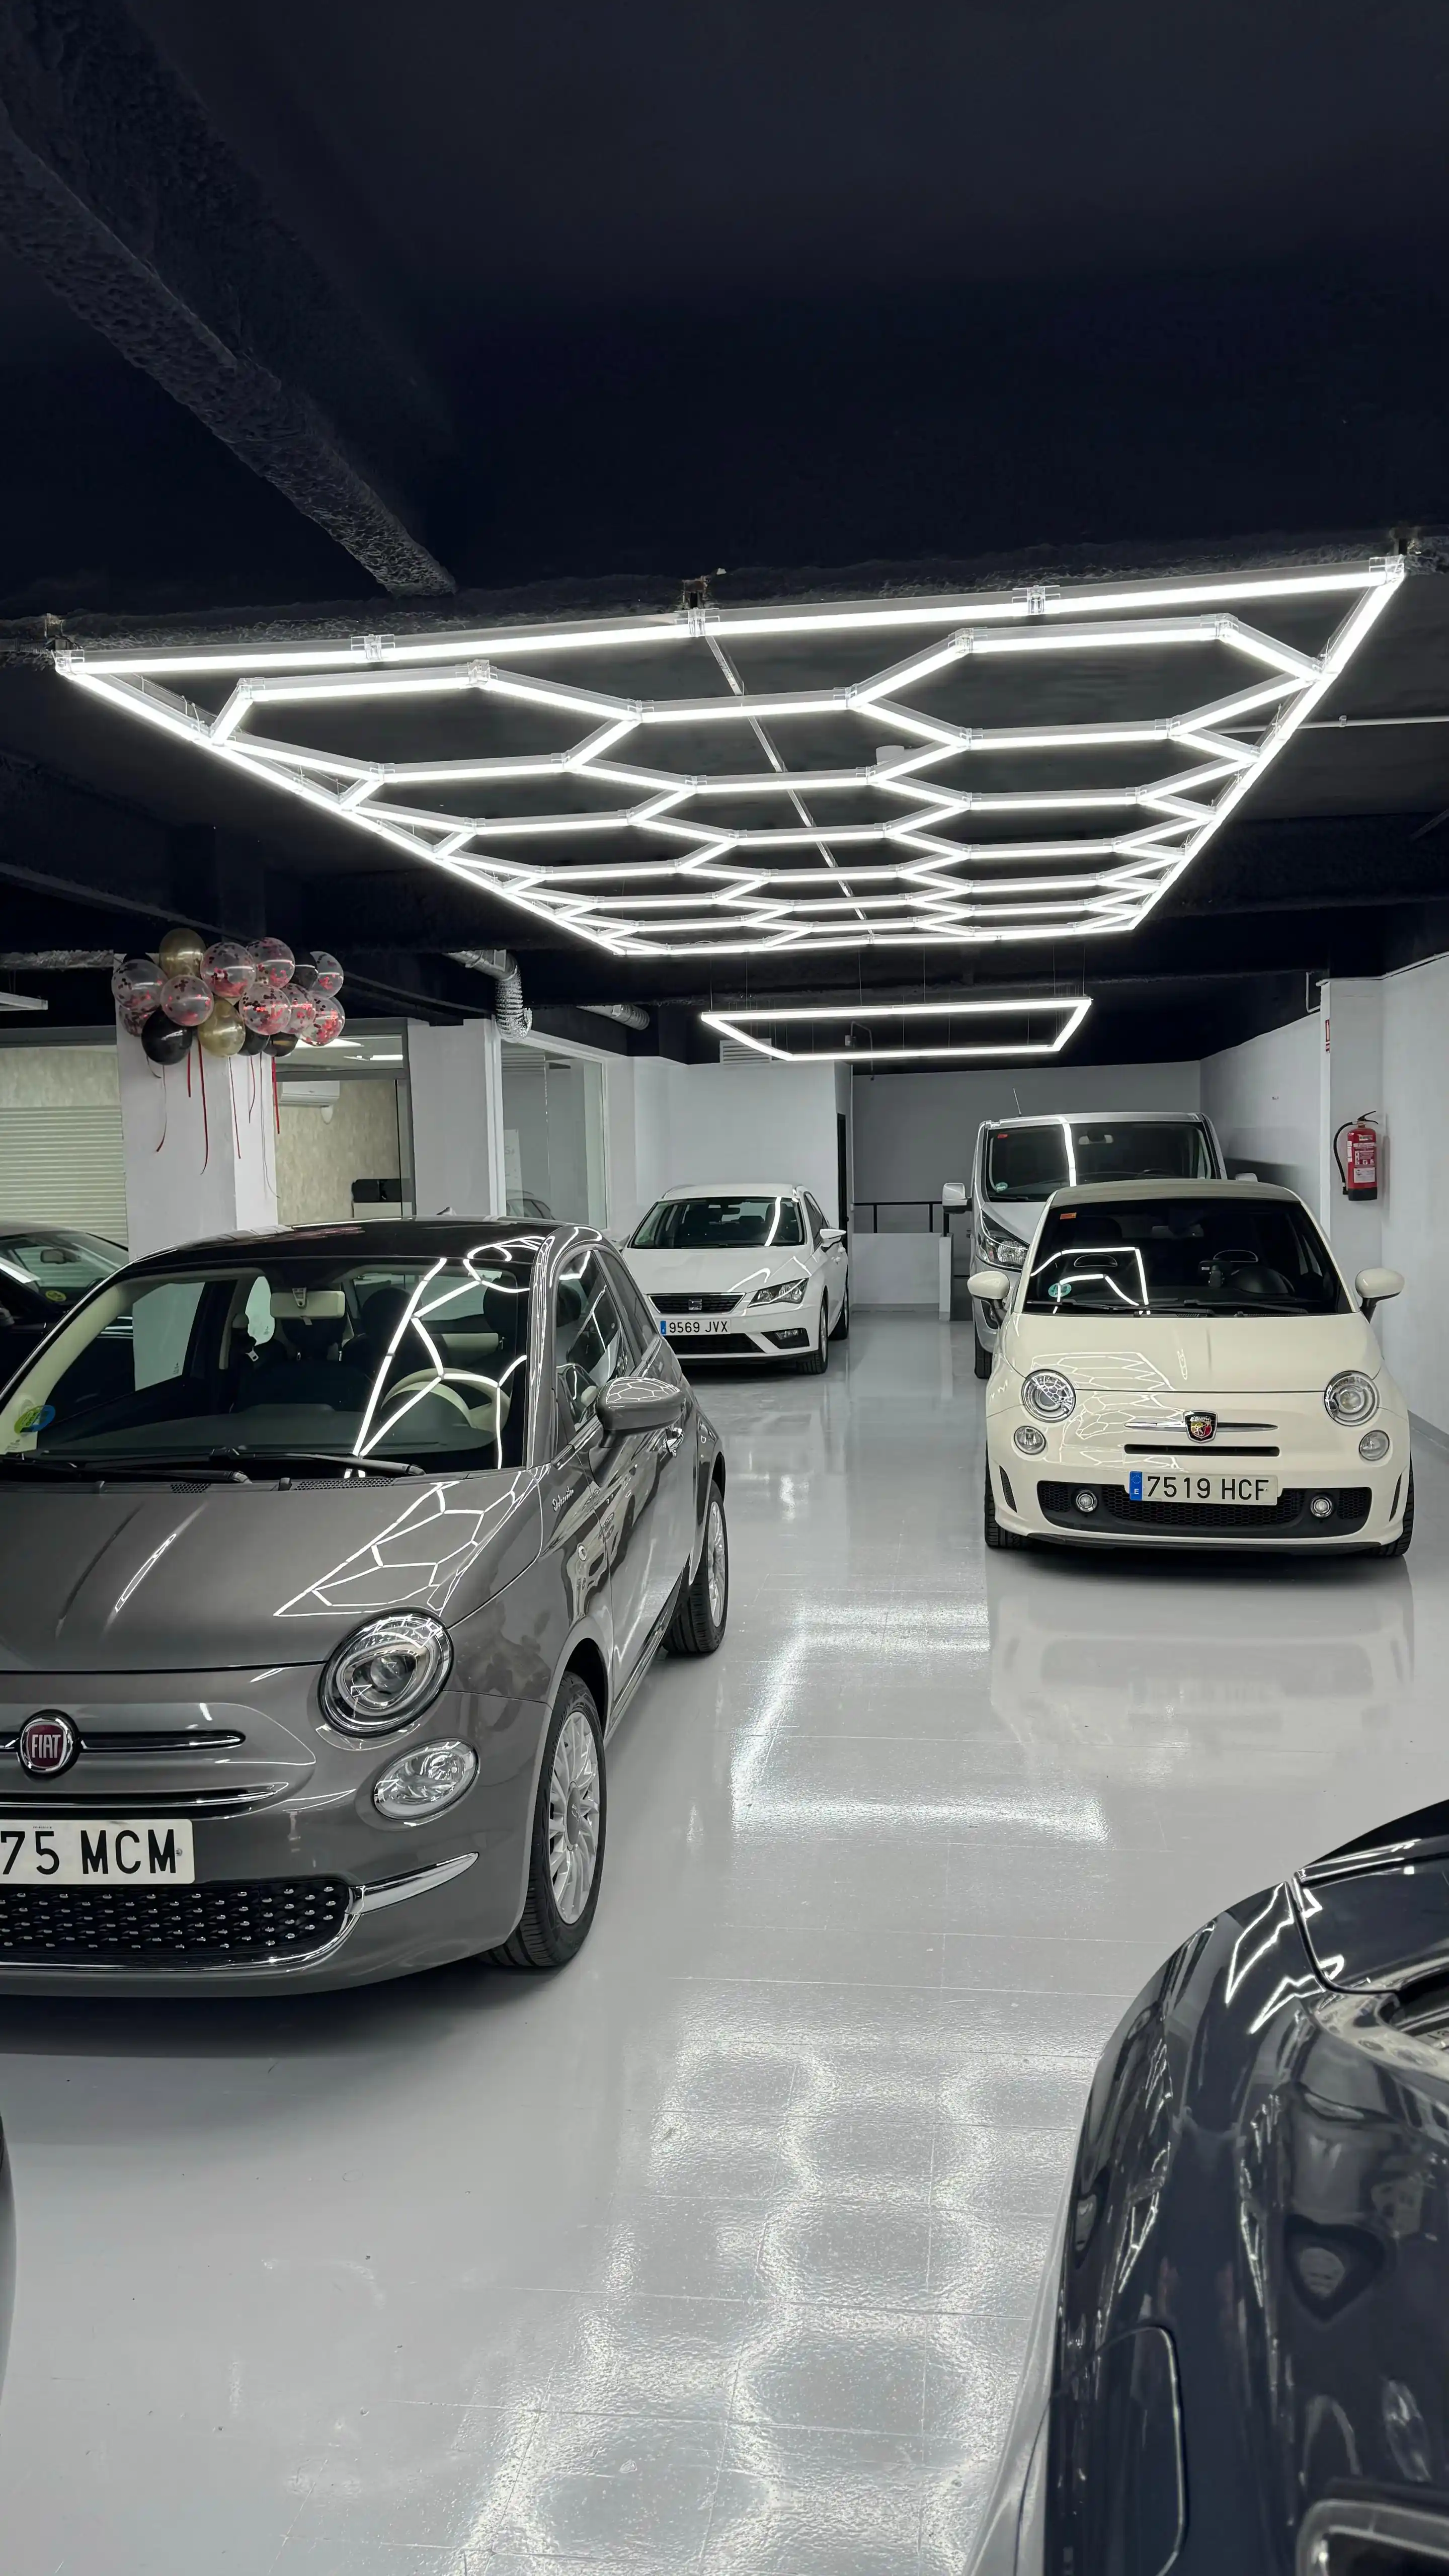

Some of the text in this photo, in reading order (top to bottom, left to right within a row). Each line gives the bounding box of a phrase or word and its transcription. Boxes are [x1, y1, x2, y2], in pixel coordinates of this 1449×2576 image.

[669, 1322, 700, 1333] 9569
[705, 1321, 728, 1333] JVX
[1147, 1476, 1269, 1501] 7519 HCF
[32, 1734, 61, 1758] FIAT
[0, 1829, 176, 1875] 75 MCM
